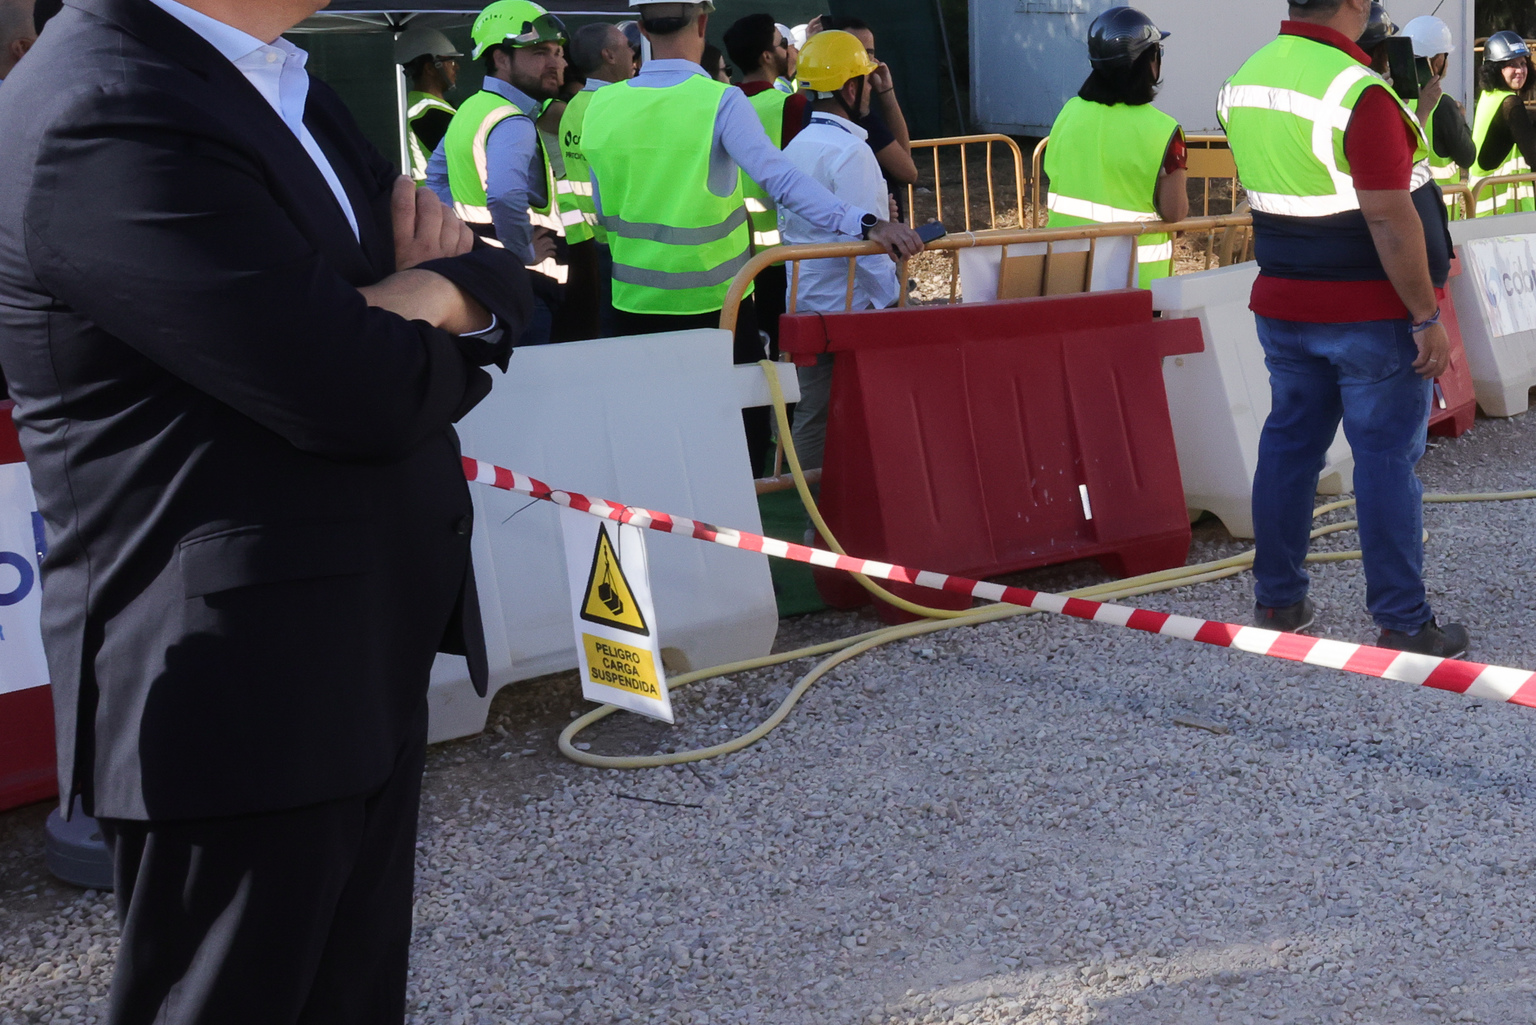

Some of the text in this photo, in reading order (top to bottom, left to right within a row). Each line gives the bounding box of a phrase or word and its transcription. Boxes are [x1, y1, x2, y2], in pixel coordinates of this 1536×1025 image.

[595, 642, 640, 664] PELIGRO
[602, 657, 640, 677] CARGA
[591, 667, 658, 695] SUSPENDIDA
